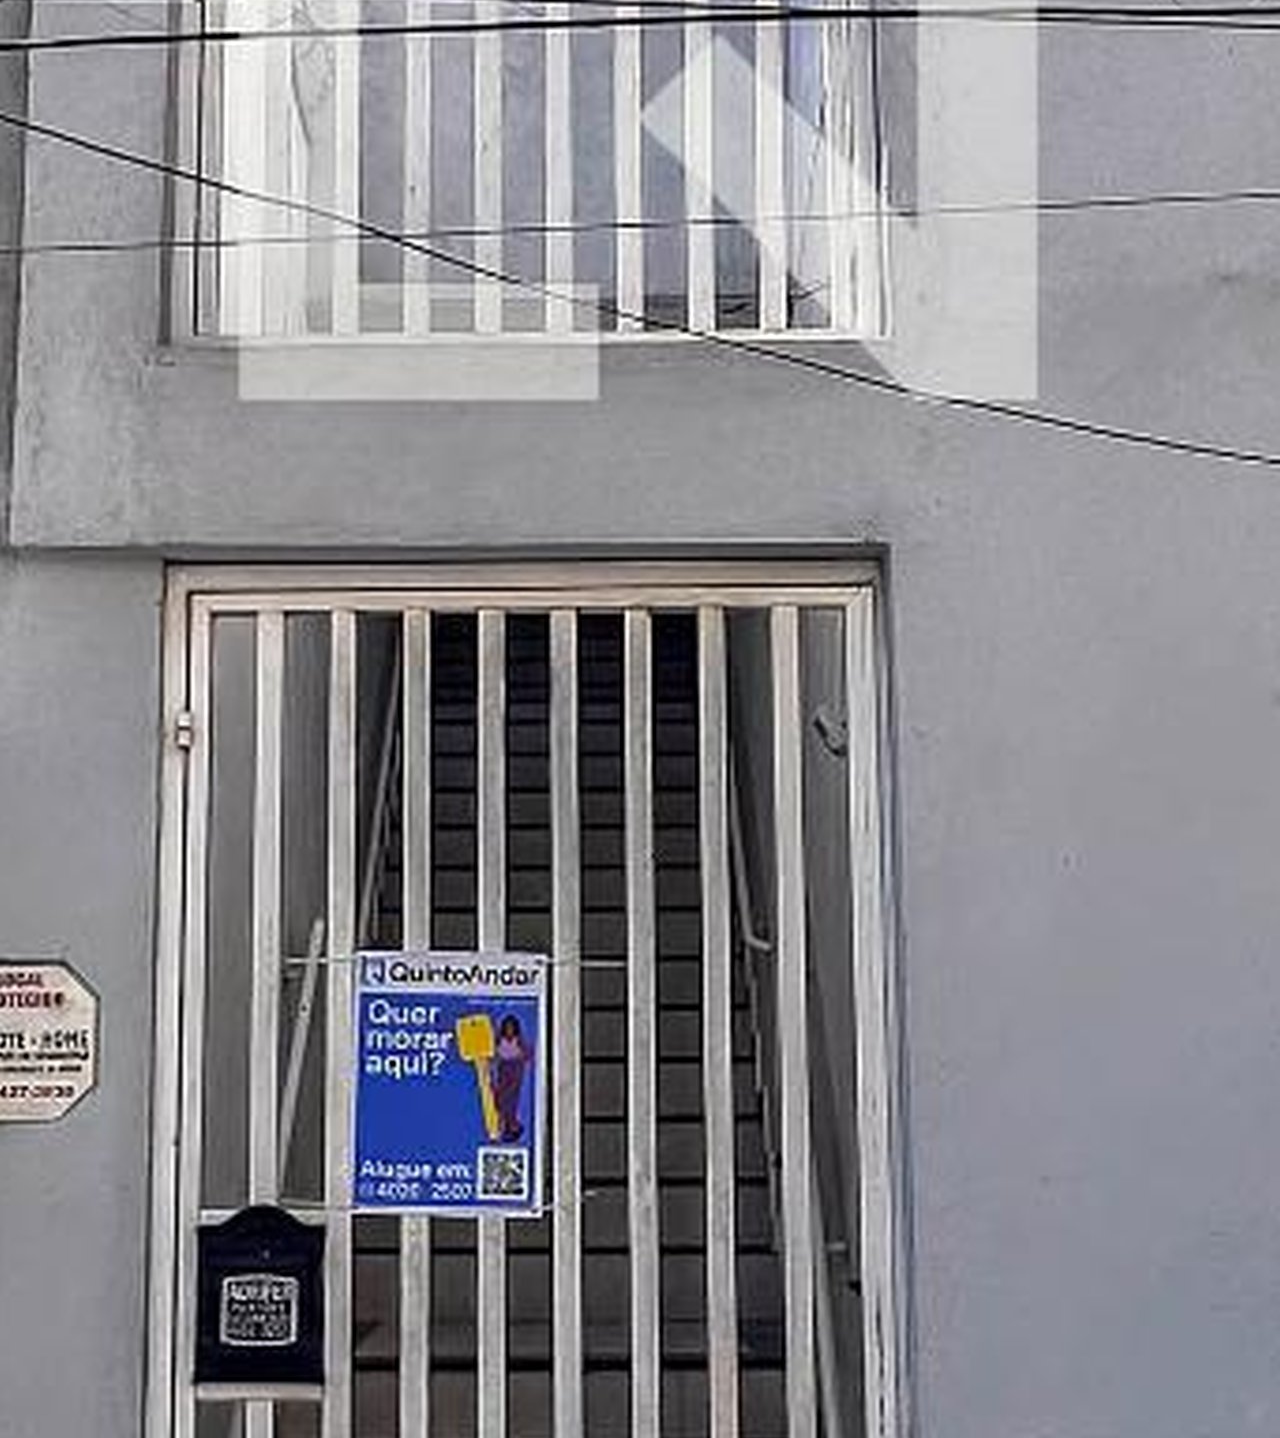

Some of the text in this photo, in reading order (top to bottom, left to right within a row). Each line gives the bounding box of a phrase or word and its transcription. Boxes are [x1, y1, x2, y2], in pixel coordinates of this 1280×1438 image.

[388, 962, 540, 986] QuintoAndar
[368, 1000, 440, 1024] Quer
[366, 1031, 453, 1050] morar
[365, 1053, 446, 1080] aqui?
